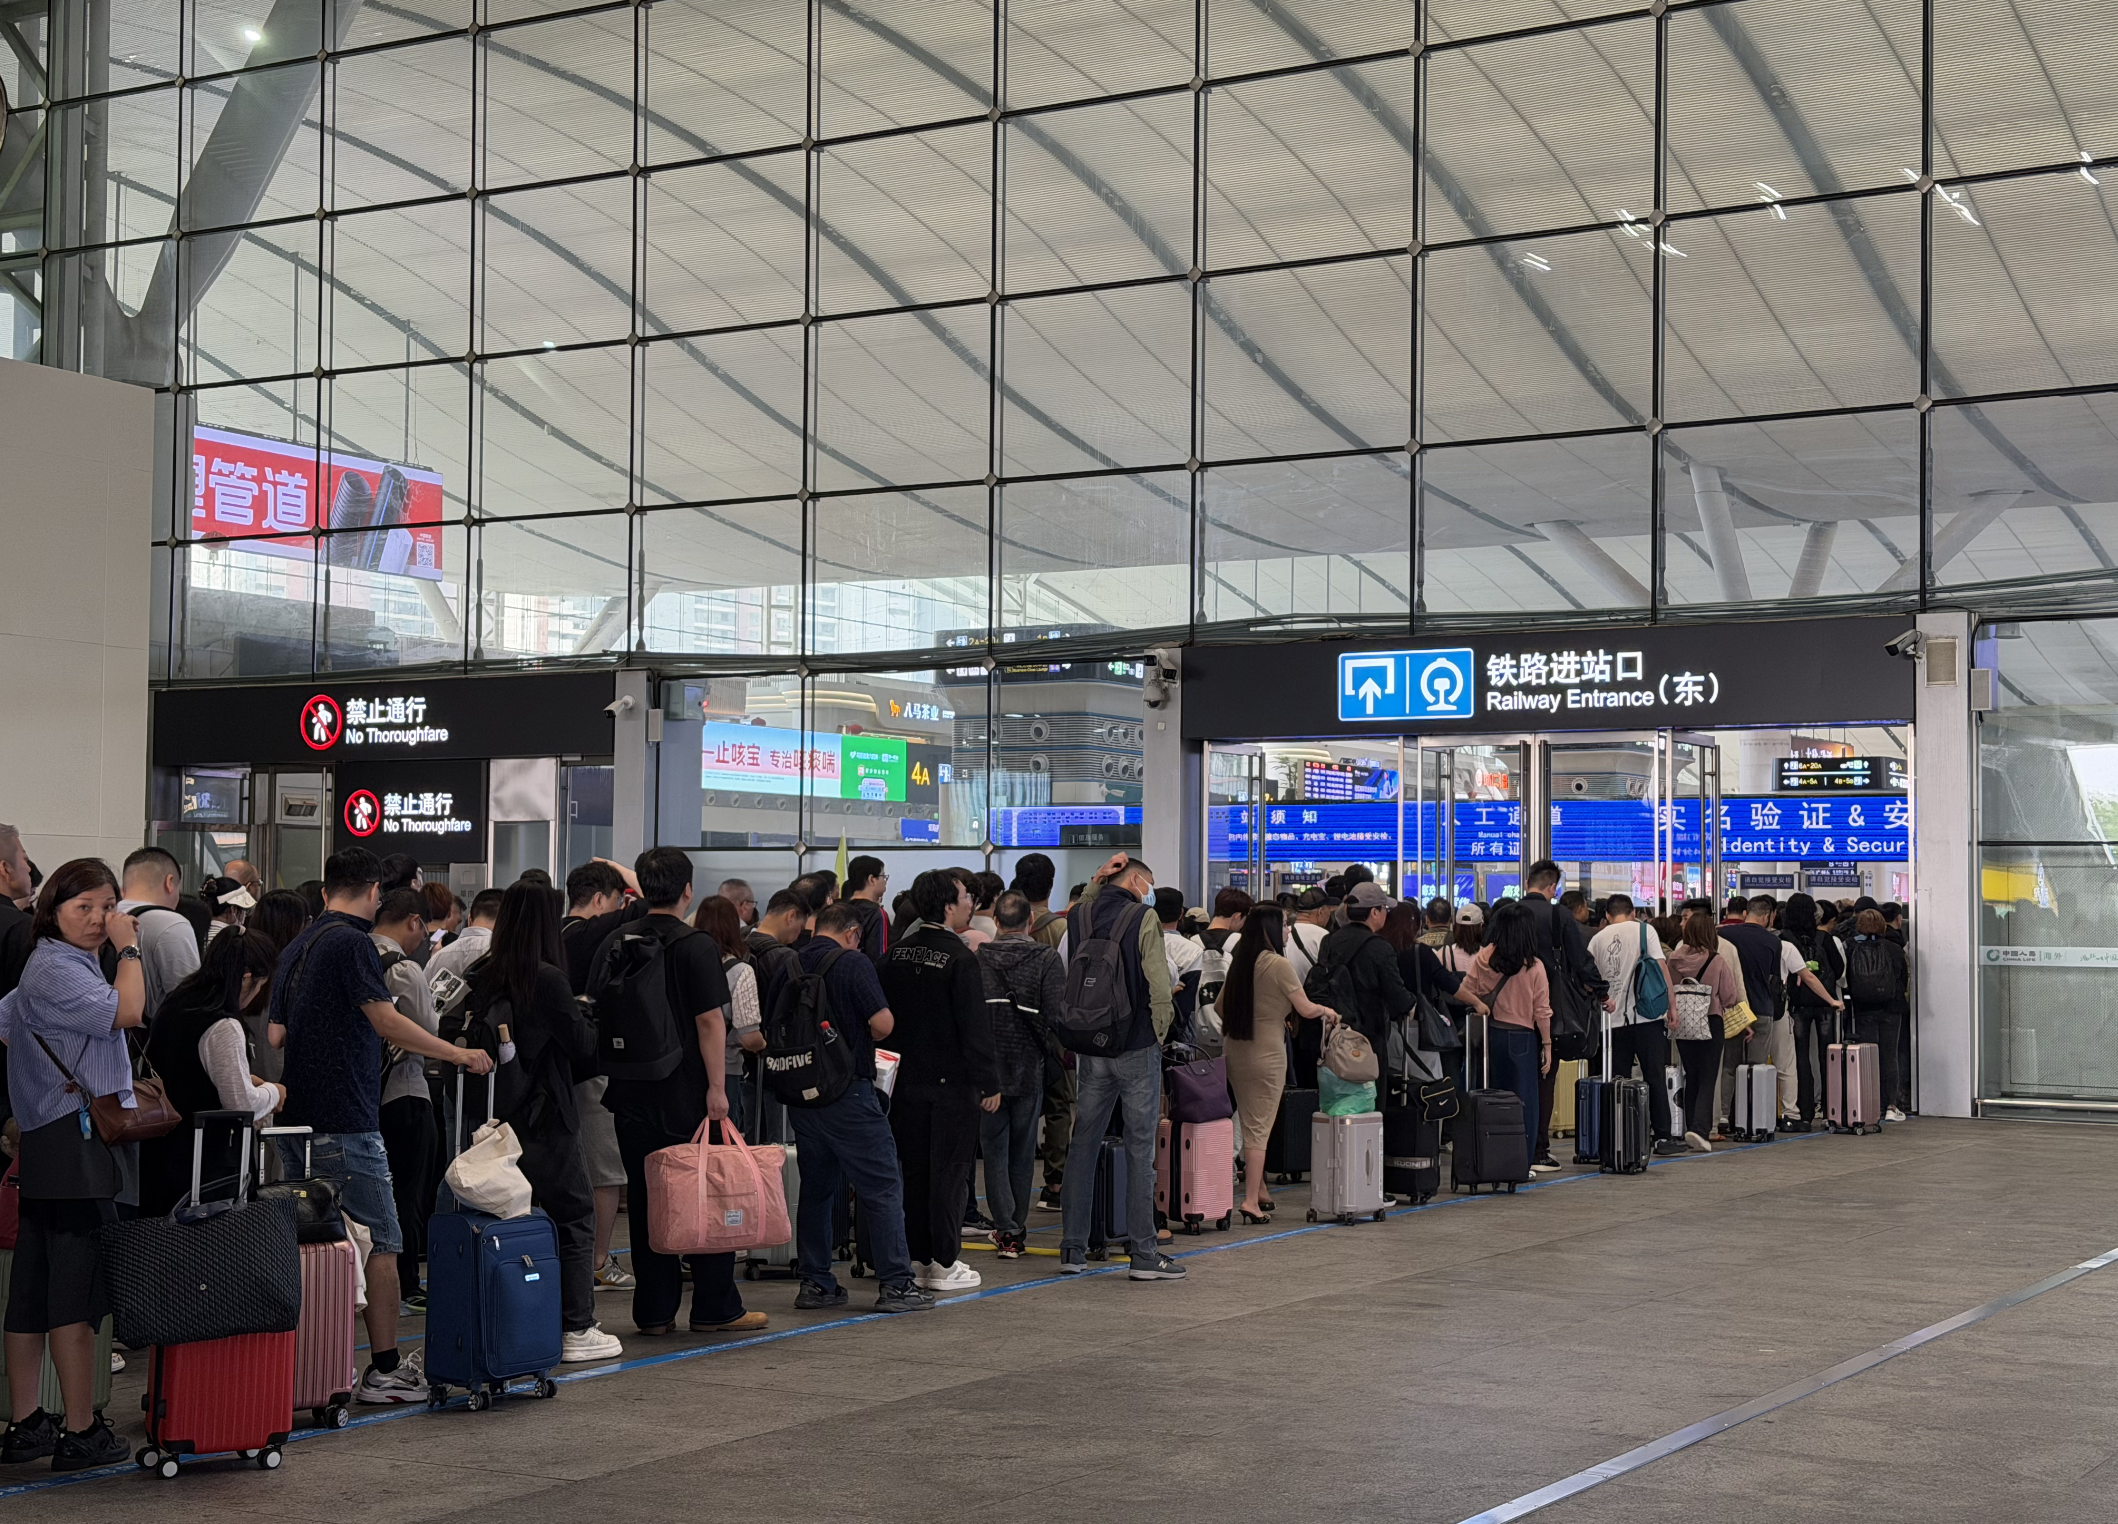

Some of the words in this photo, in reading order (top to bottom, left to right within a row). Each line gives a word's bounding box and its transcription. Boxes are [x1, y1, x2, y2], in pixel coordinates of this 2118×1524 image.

[193, 454, 311, 534] 管道
[1486, 648, 1643, 687] 铁路进站口
[1486, 691, 1561, 713] Railway
[1567, 688, 1655, 709] Entrance
[1658, 671, 1719, 706] (东)
[346, 696, 427, 725] 禁止通行
[903, 702, 940, 721] 八马茶业
[346, 728, 364, 744] No
[366, 726, 449, 746] Thoroughfare
[911, 761, 939, 786] 4A
[384, 792, 453, 816] 禁止通行
[384, 818, 399, 833] No
[401, 817, 472, 835] Thoroughfare
[1721, 836, 1811, 855] Identity
[1823, 837, 1835, 853] &
[1847, 837, 1906, 854] Secur
[766, 1051, 812, 1071] BADFIVE
